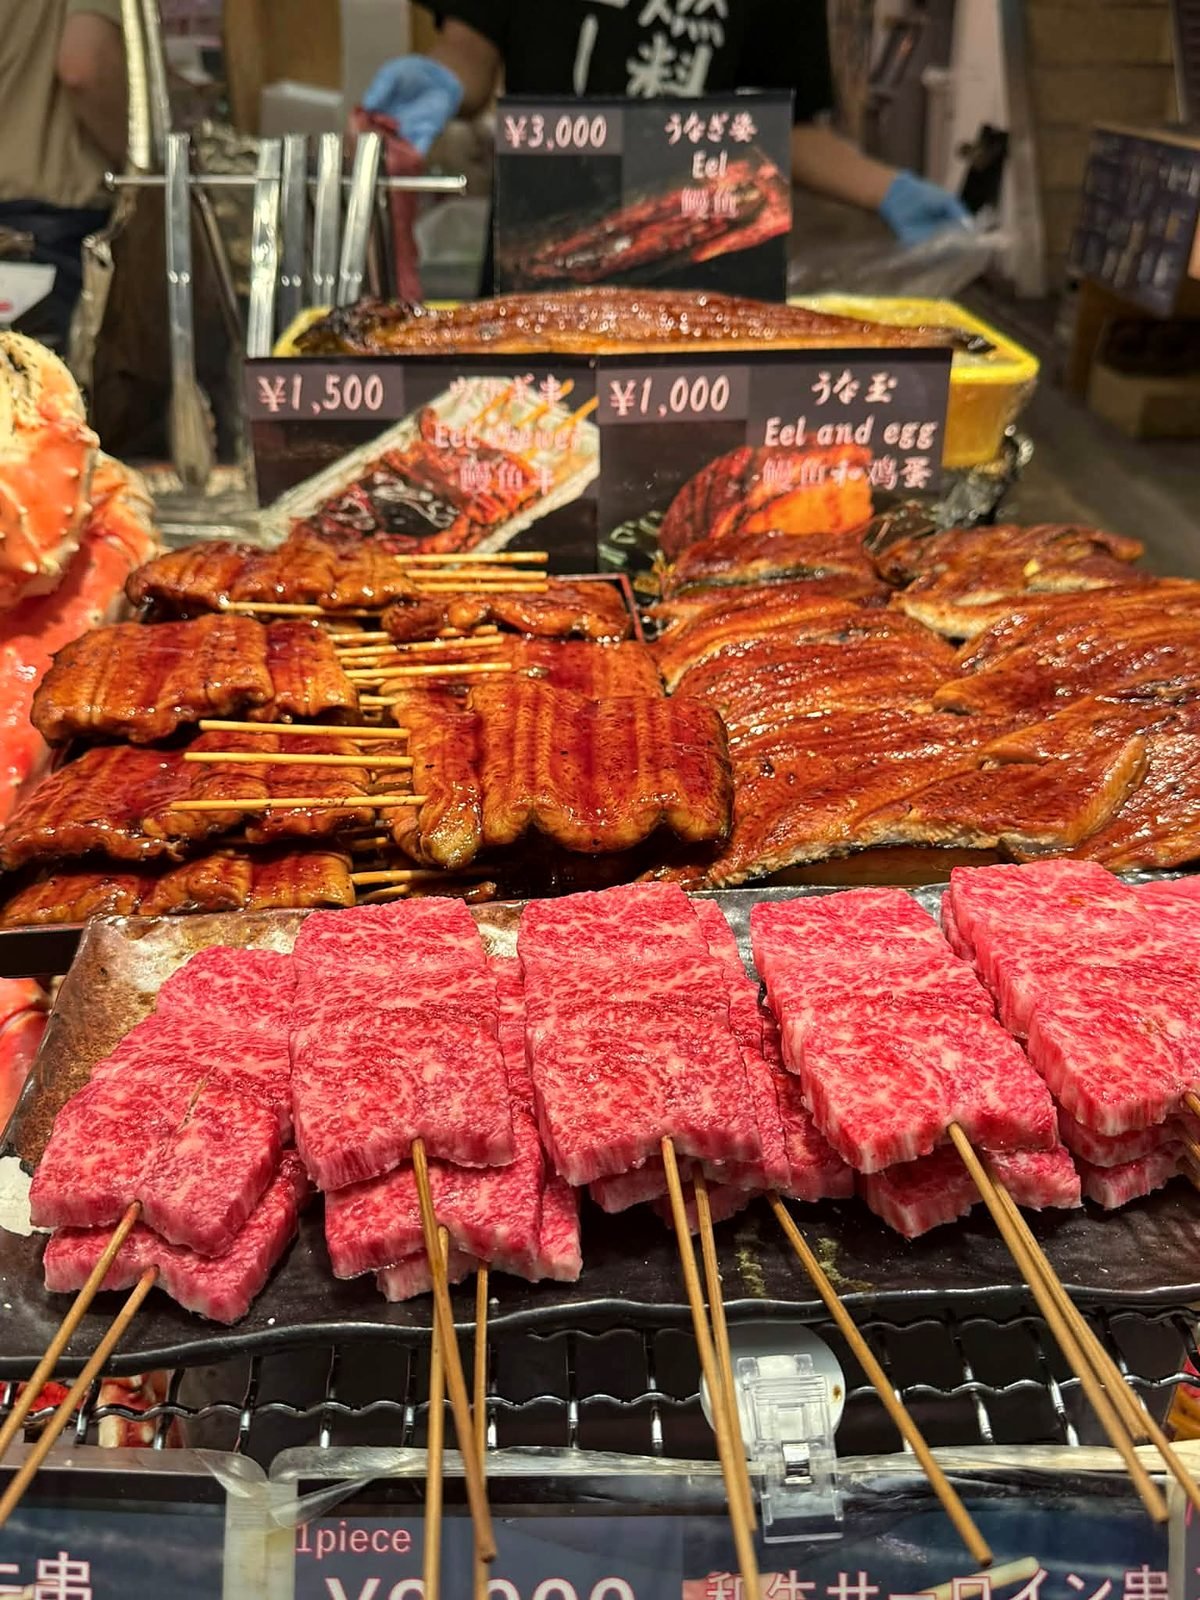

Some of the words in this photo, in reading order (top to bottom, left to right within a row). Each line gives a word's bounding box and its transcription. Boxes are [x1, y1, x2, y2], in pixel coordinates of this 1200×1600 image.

[504, 114, 608, 150] ¥3,000
[692, 149, 728, 179] Eel
[257, 373, 385, 416] ¥1,500
[610, 375, 731, 416] ¥1,000
[811, 369, 898, 405] うな玉
[434, 421, 480, 449] Eel
[764, 416, 807, 447] Eel
[816, 415, 876, 447] and
[883, 420, 939, 451] egg
[296, 1521, 411, 1559] 1piece
